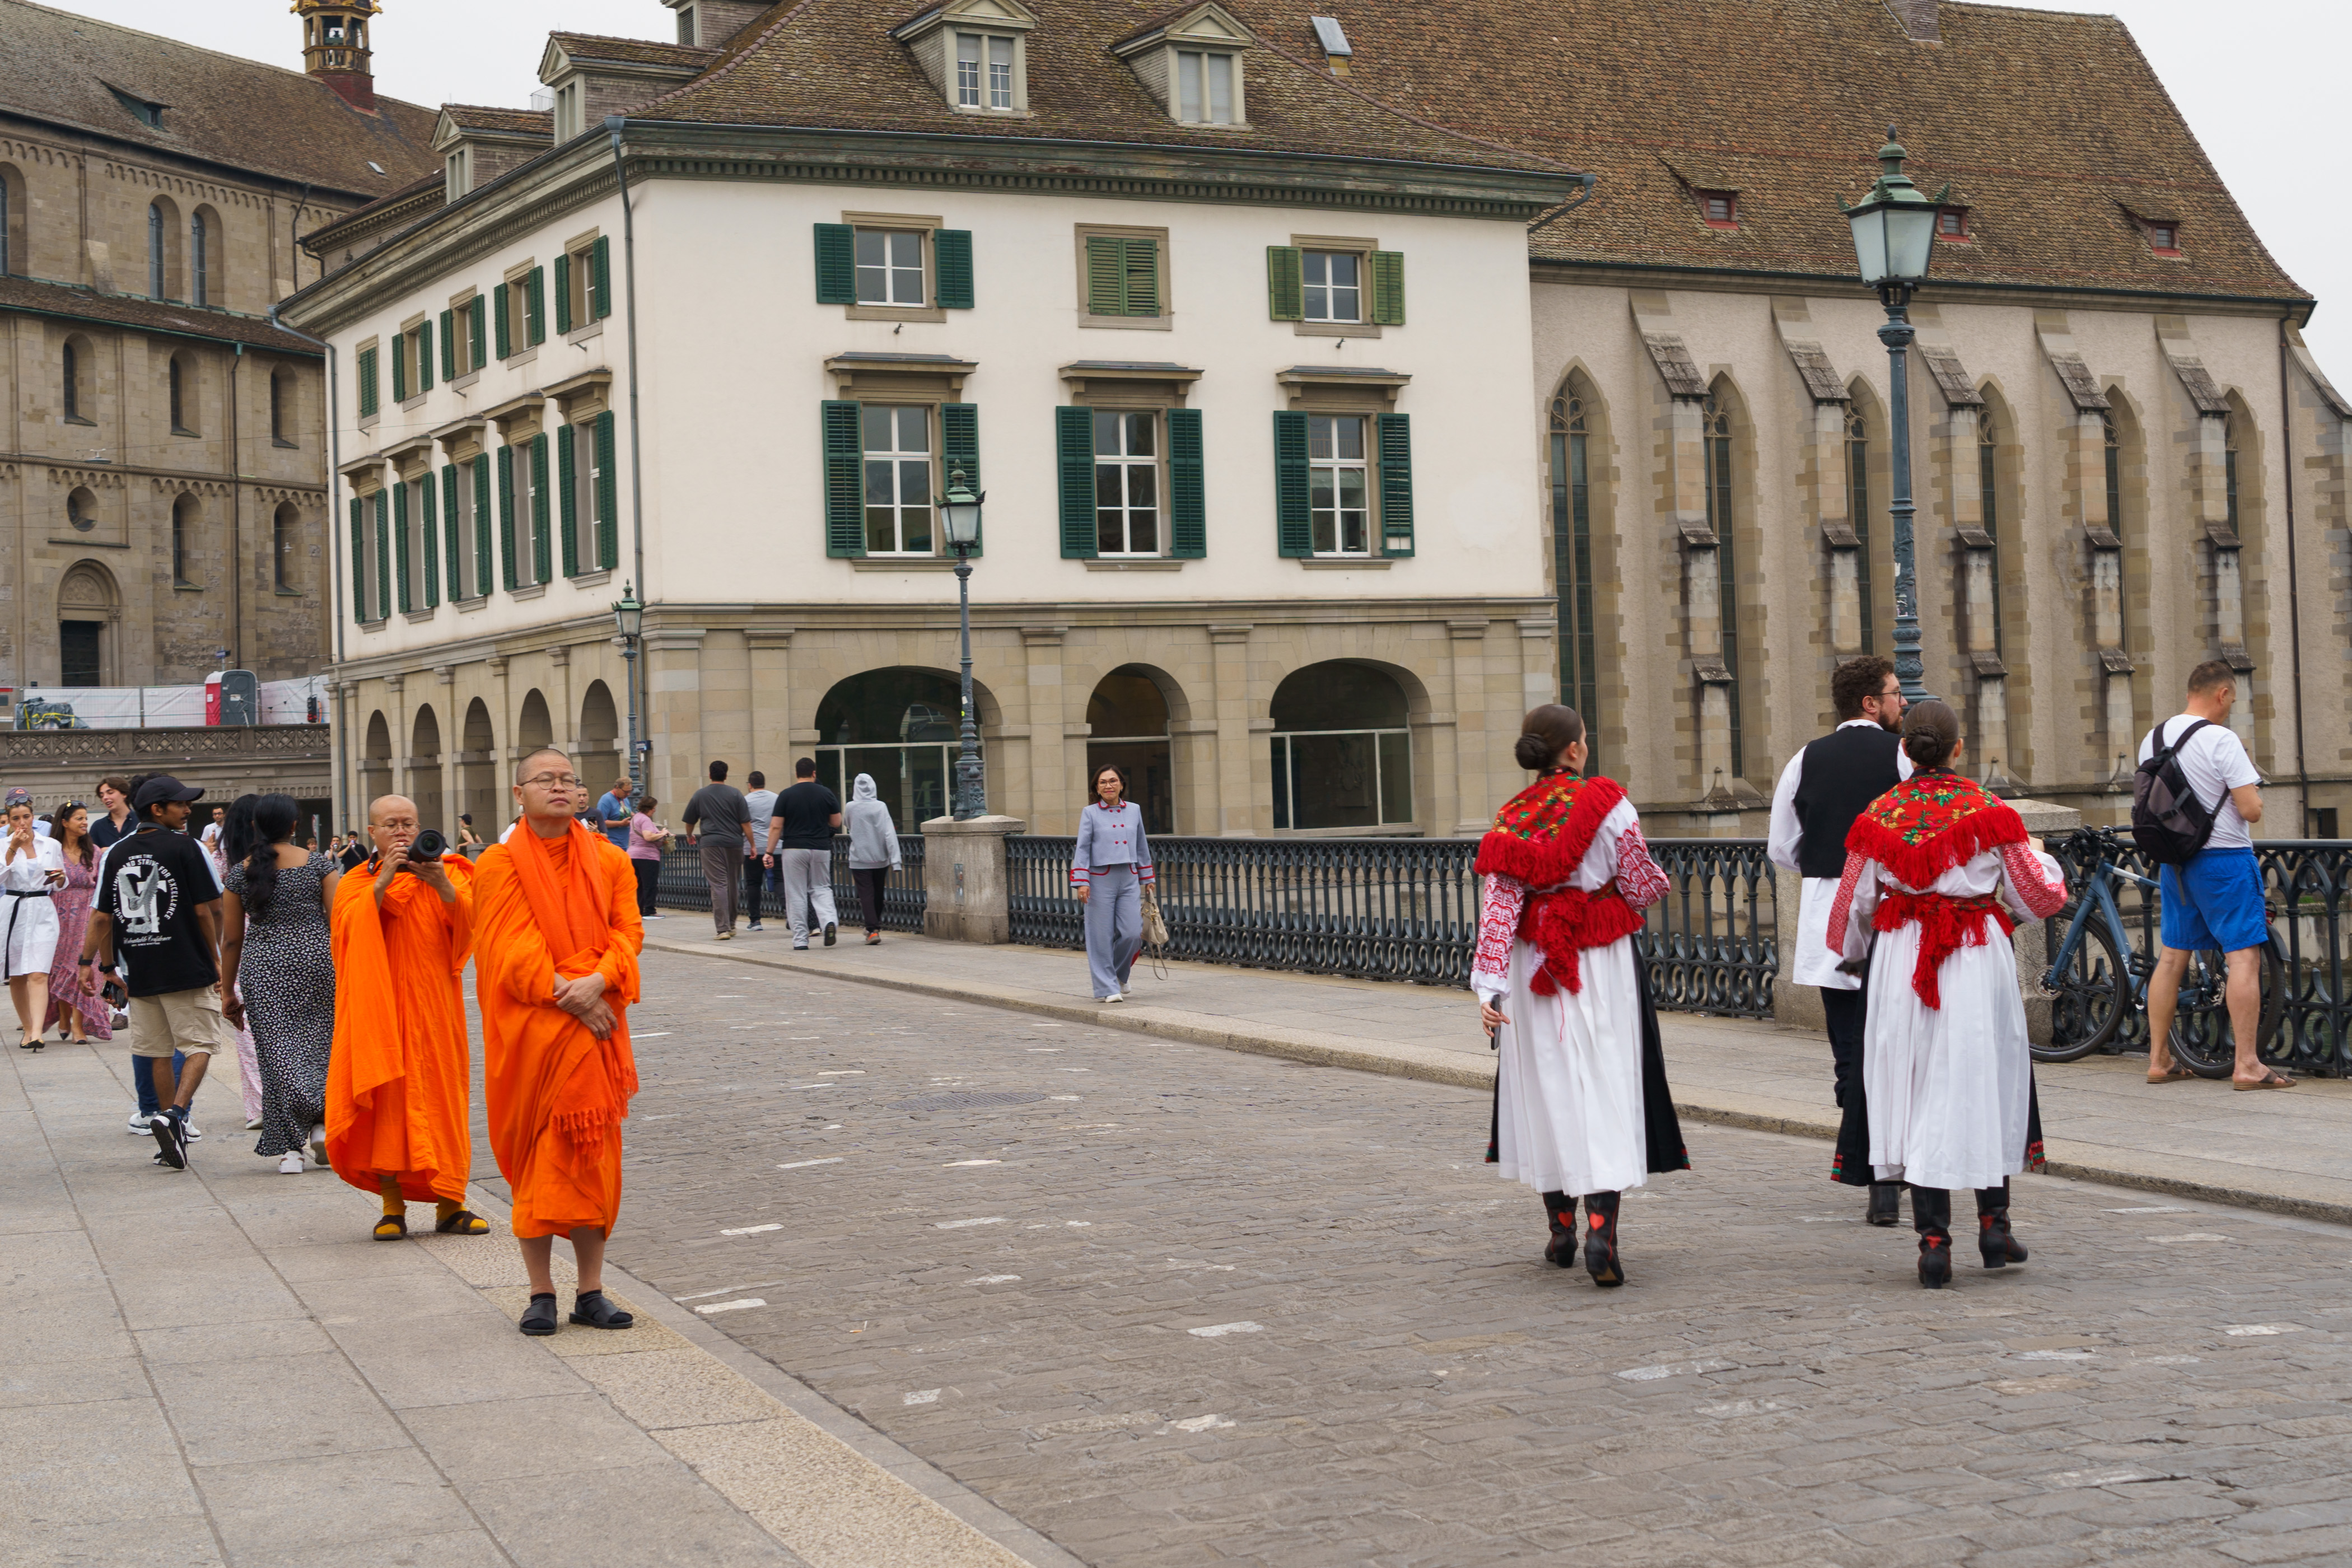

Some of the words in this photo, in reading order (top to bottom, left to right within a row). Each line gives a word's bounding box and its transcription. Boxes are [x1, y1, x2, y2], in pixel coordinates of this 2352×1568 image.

[158, 866, 171, 878] FOR
[164, 878, 179, 920] EXCELLENCE
[113, 908, 125, 923] PUSH
